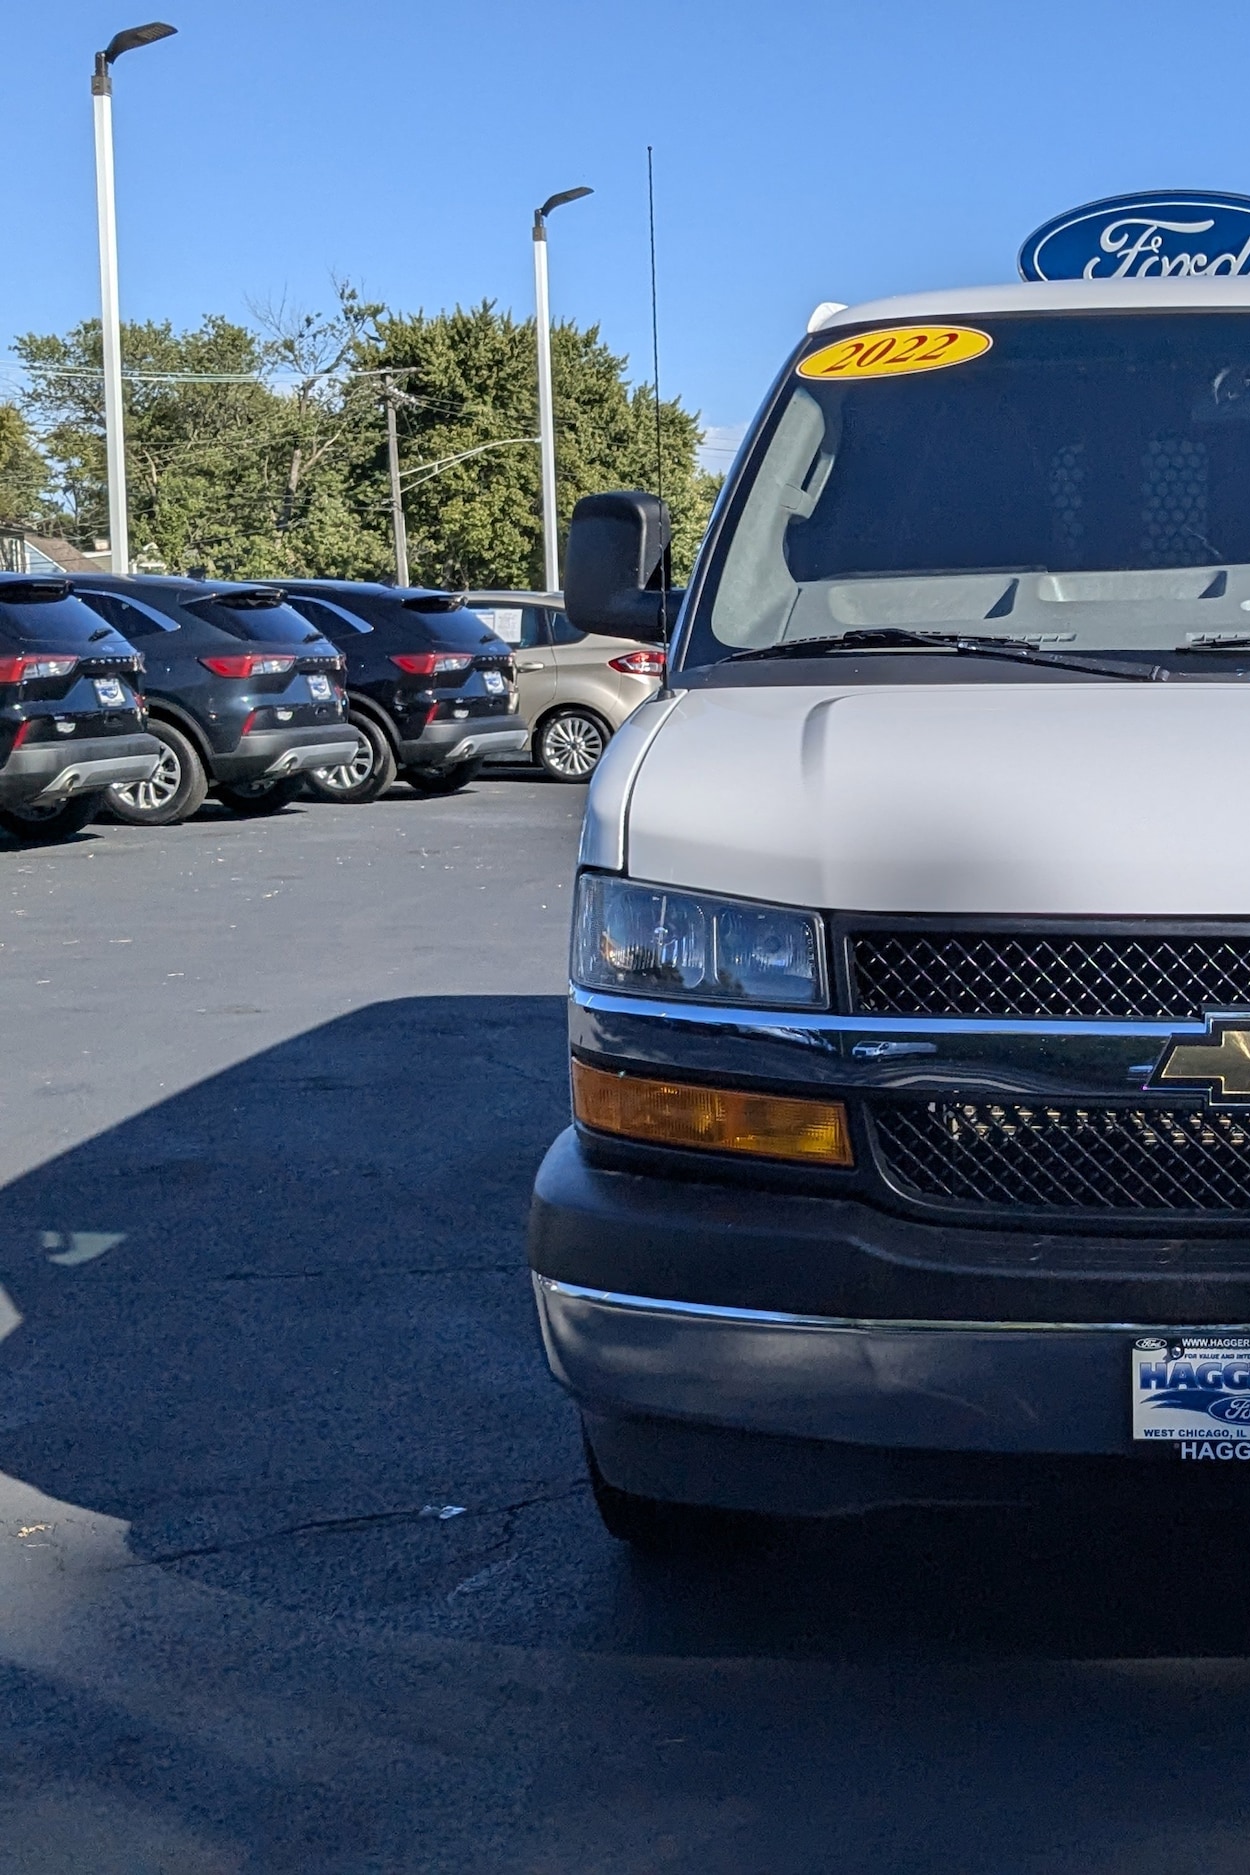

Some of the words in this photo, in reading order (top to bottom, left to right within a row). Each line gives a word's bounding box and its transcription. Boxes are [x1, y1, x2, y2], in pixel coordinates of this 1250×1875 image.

[820, 332, 959, 374] 2022
[1143, 1429, 1175, 1437] WEST
[1178, 1429, 1233, 1439] CHICAGO,
[1236, 1429, 1247, 1437] IL
